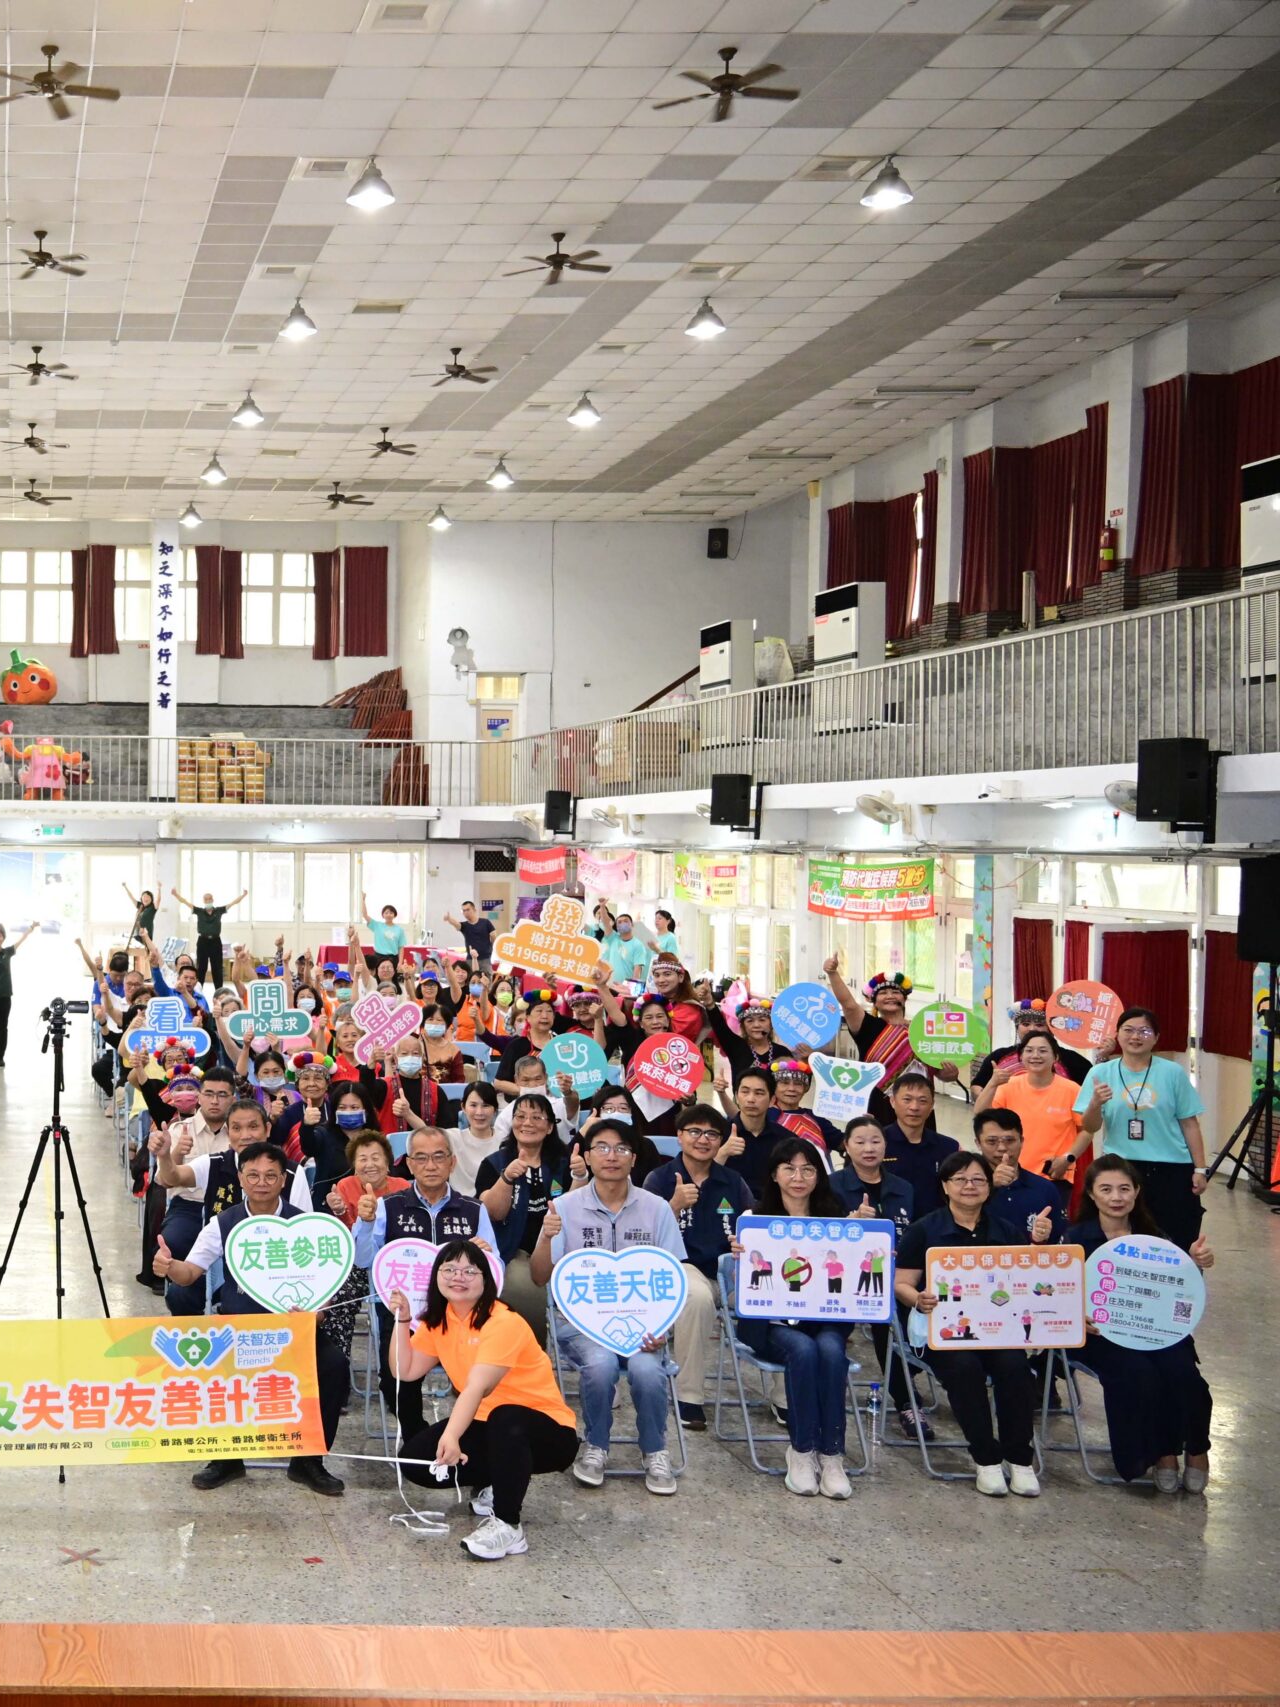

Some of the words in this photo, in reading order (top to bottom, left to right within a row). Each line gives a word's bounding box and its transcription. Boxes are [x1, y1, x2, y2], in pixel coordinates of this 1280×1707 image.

[543, 897, 583, 939] 撥
[529, 930, 585, 957] 撥打110
[252, 983, 284, 1017] 問
[149, 999, 183, 1033] 看
[355, 995, 391, 1033] 留
[774, 1005, 820, 1047] 規律運動
[918, 1040, 975, 1056] 均衡飲食
[638, 1060, 692, 1094] 戒菸檳酒
[819, 1090, 865, 1107] 失智友善
[771, 1224, 861, 1239] 遠離失智症
[238, 1235, 344, 1272] 友善參與
[1113, 1242, 1140, 1259] 4點
[564, 1268, 676, 1305] 友善天使
[236, 1332, 290, 1346] 失智友善
[237, 1345, 280, 1357] Dementia
[237, 1355, 272, 1367] Friends
[111, 1439, 150, 1449] 協辦單位
[160, 1431, 303, 1447] 番路鄉公所、番路鄉衛生所
